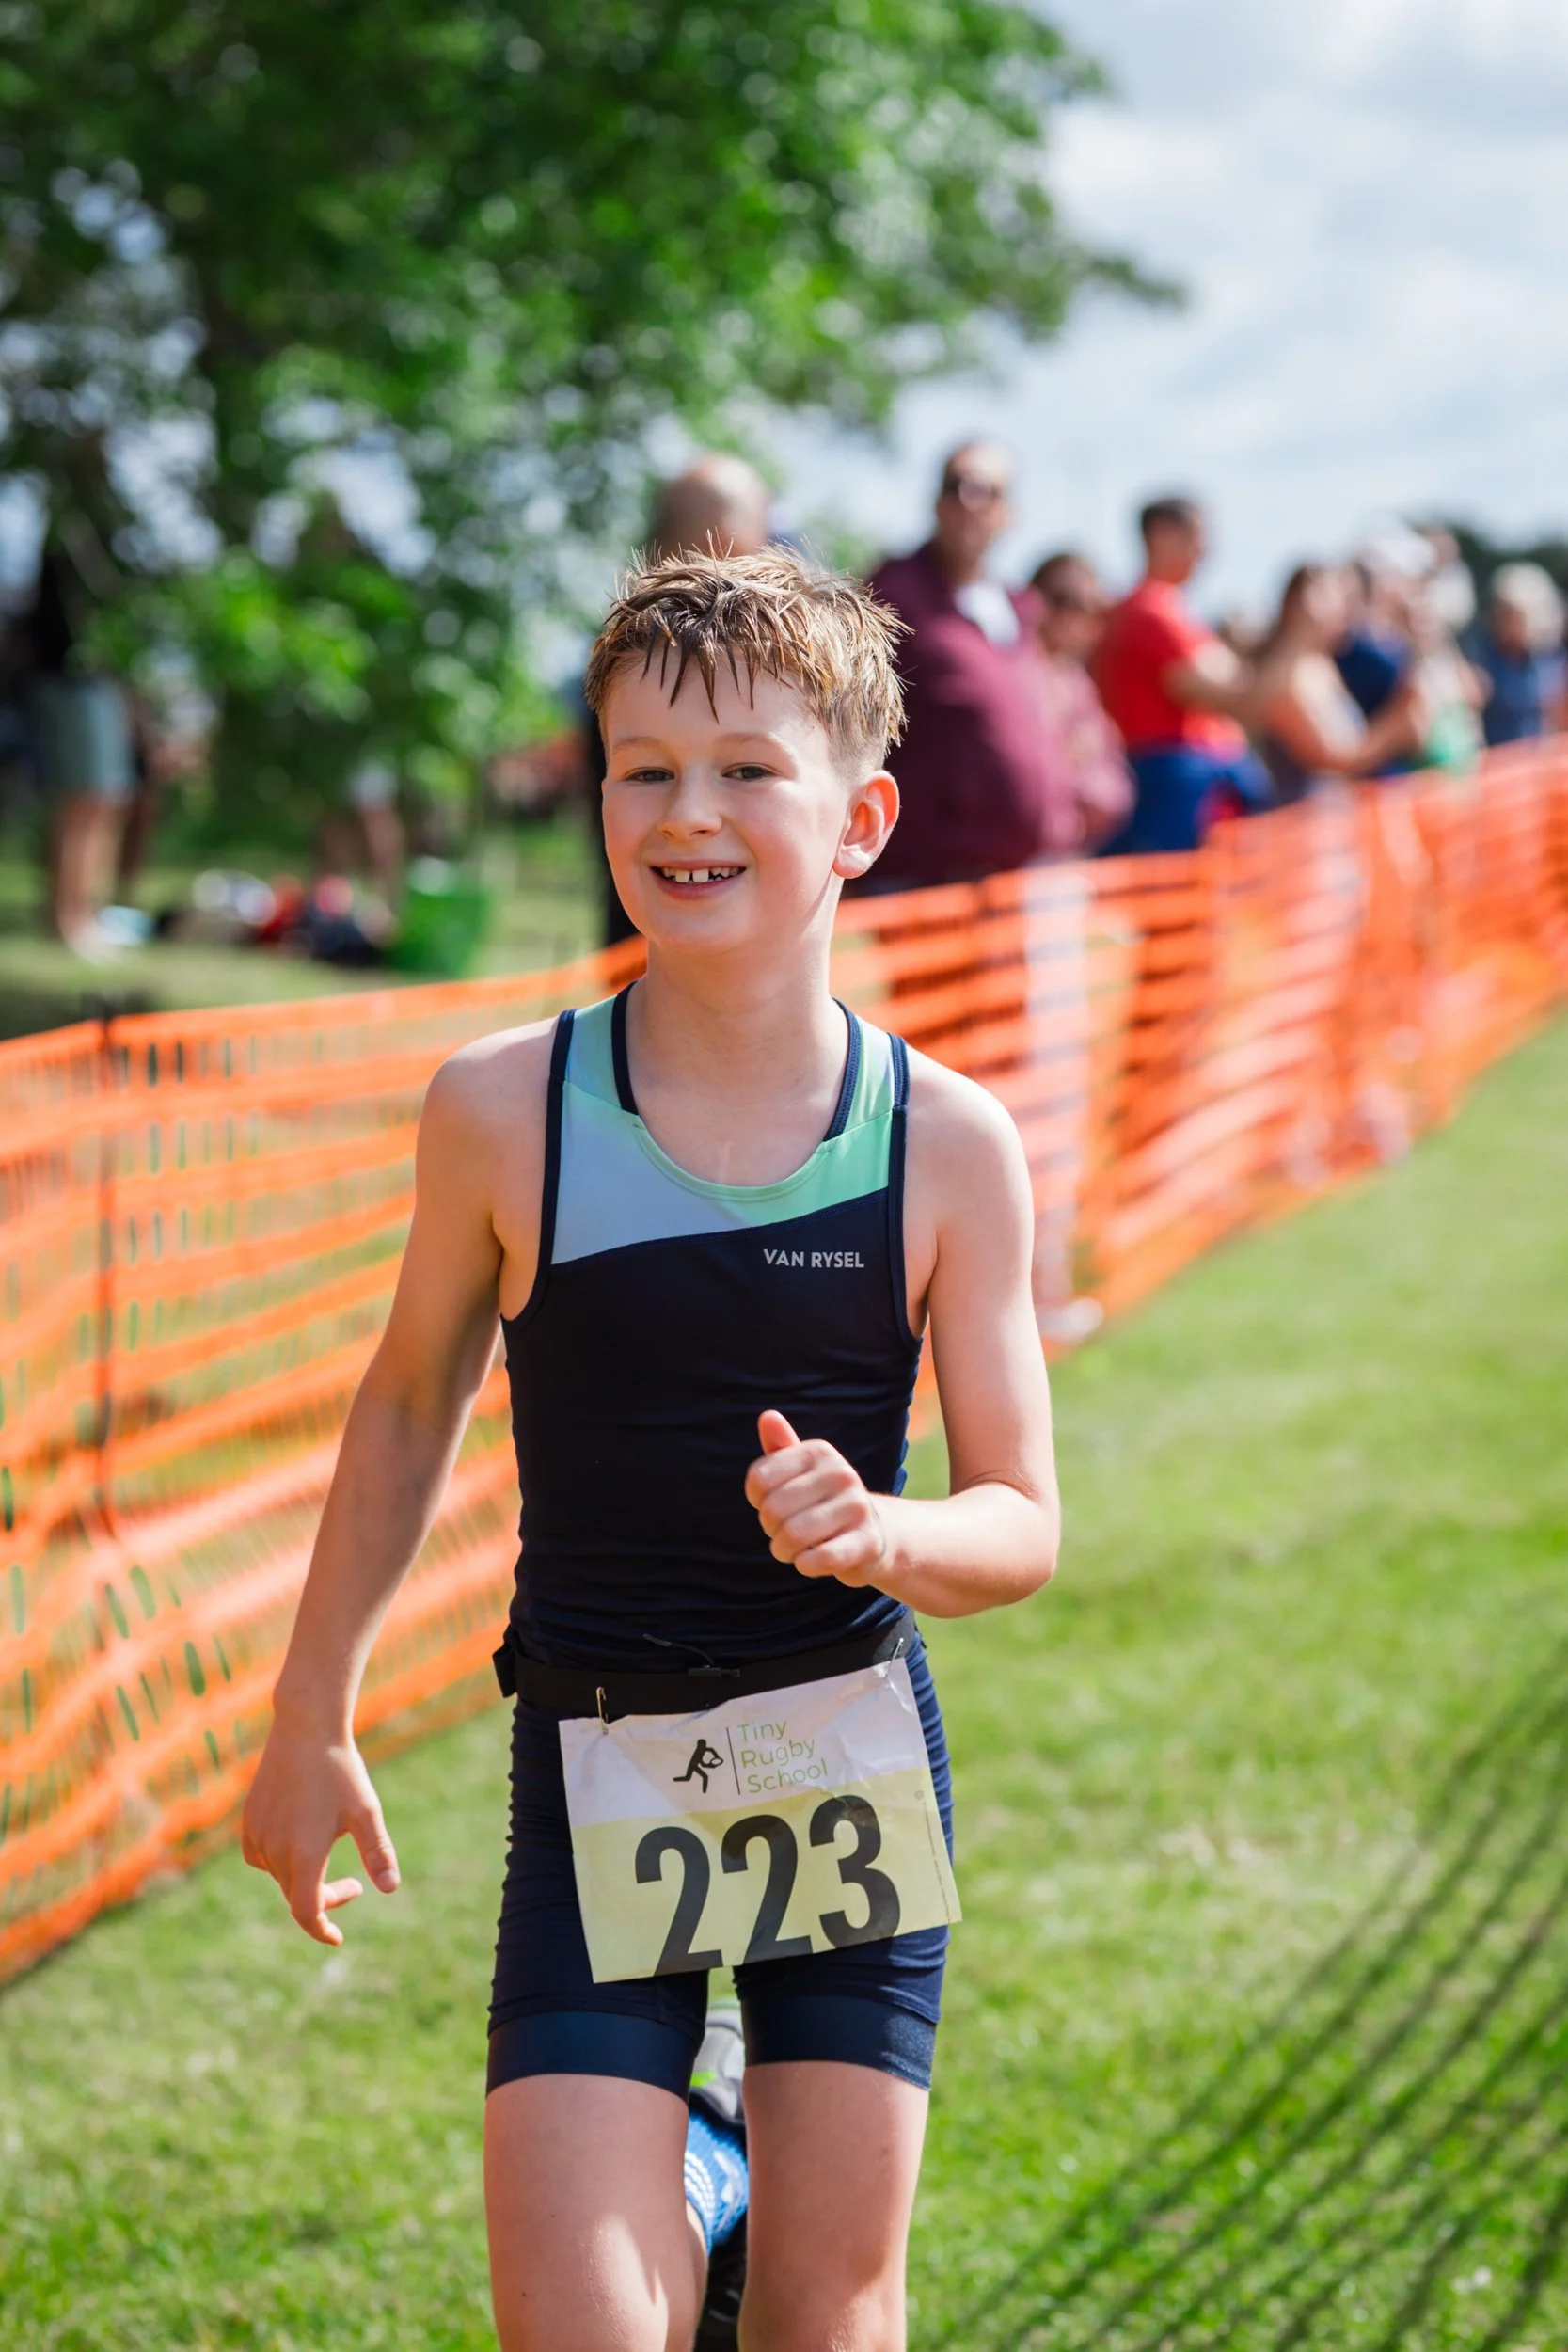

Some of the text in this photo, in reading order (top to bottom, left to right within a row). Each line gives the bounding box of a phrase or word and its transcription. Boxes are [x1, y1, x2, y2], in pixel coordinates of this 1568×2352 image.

[763, 1248, 864, 1269] VAN RYSEL
[736, 1720, 787, 1743] Tiny
[740, 1740, 816, 1769] Rugby
[747, 1759, 829, 1794] School
[635, 1795, 901, 1977] 223
